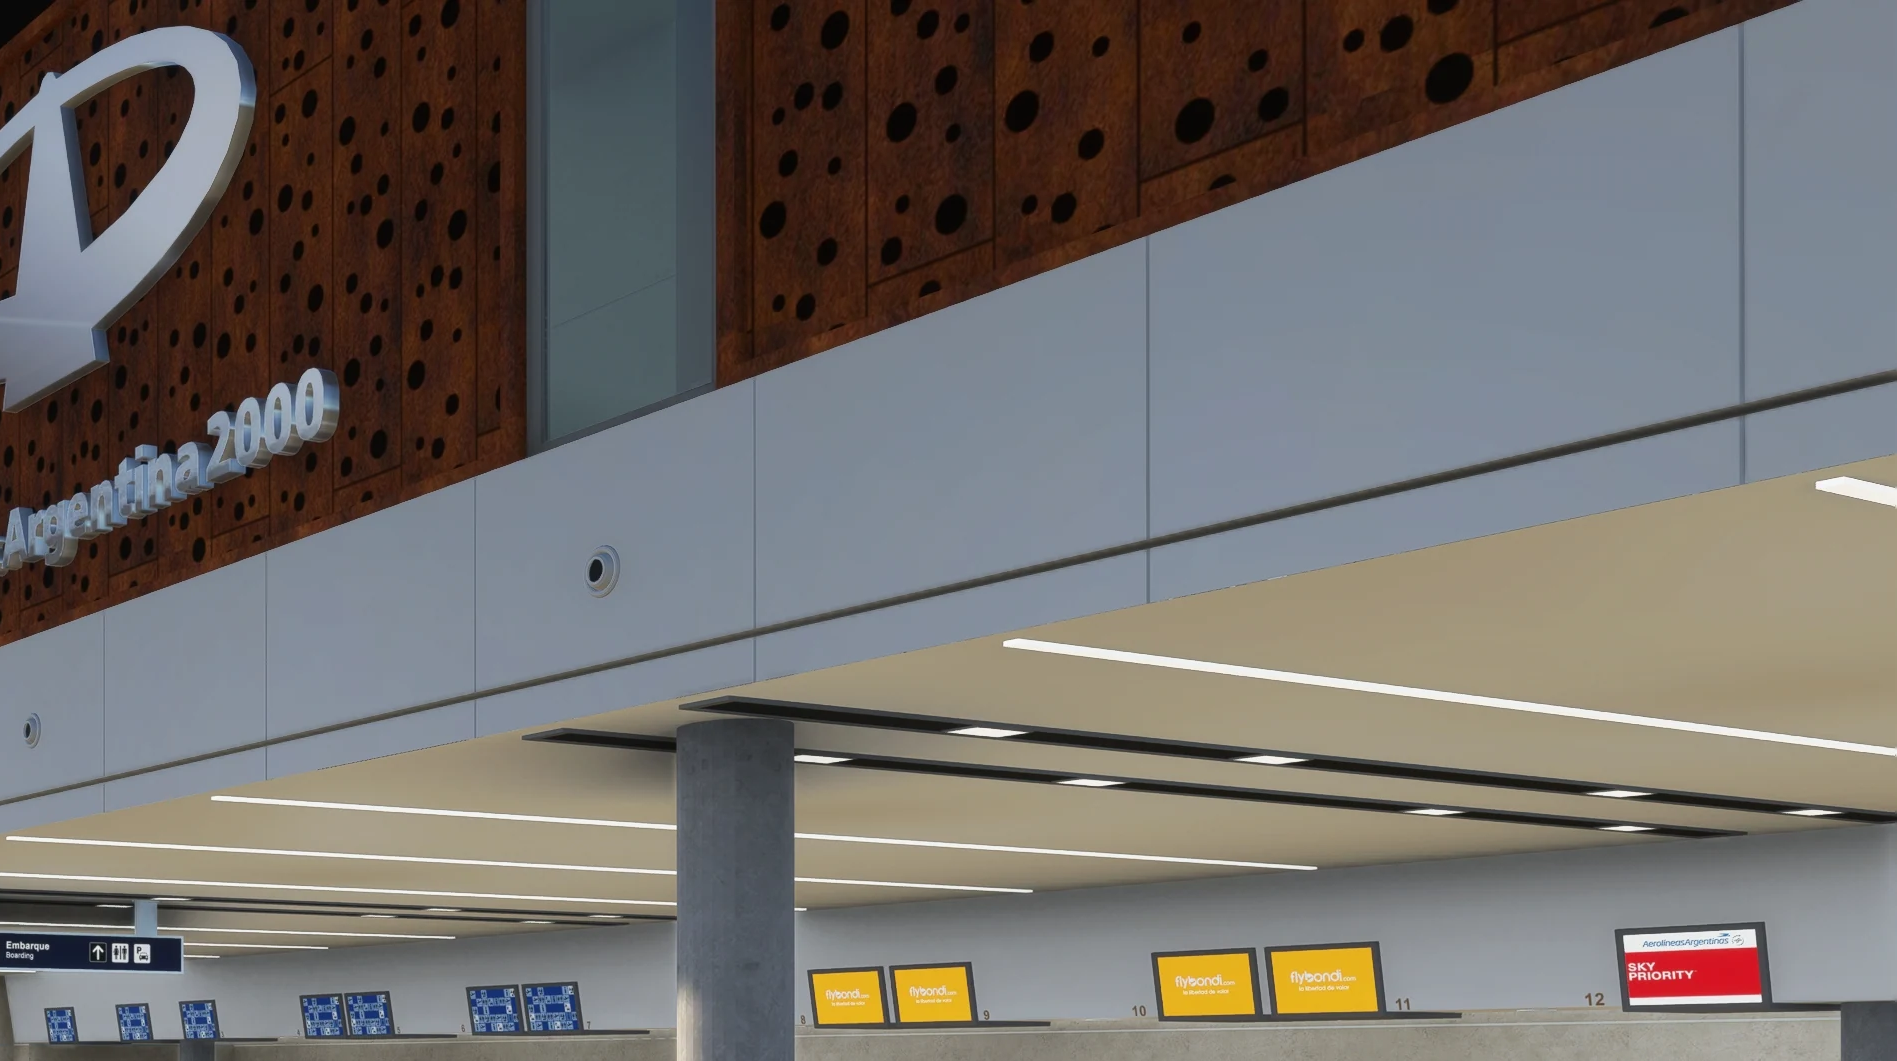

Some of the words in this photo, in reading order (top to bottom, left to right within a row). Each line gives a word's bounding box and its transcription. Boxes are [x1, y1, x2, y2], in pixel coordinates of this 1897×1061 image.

[5, 444, 209, 566] Argentina
[207, 367, 339, 483] 2000
[6, 941, 50, 951] Embarque
[6, 952, 34, 960] Boarding
[1628, 962, 1655, 971] SKY
[1629, 971, 1694, 981] PRIORITY
[1395, 998, 1410, 1010] 11
[1585, 993, 1605, 1006] 12
[984, 1010, 990, 1020] 9
[1132, 1005, 1146, 1017] 10
[801, 1015, 806, 1024] 8
[587, 1021, 591, 1029] 7
